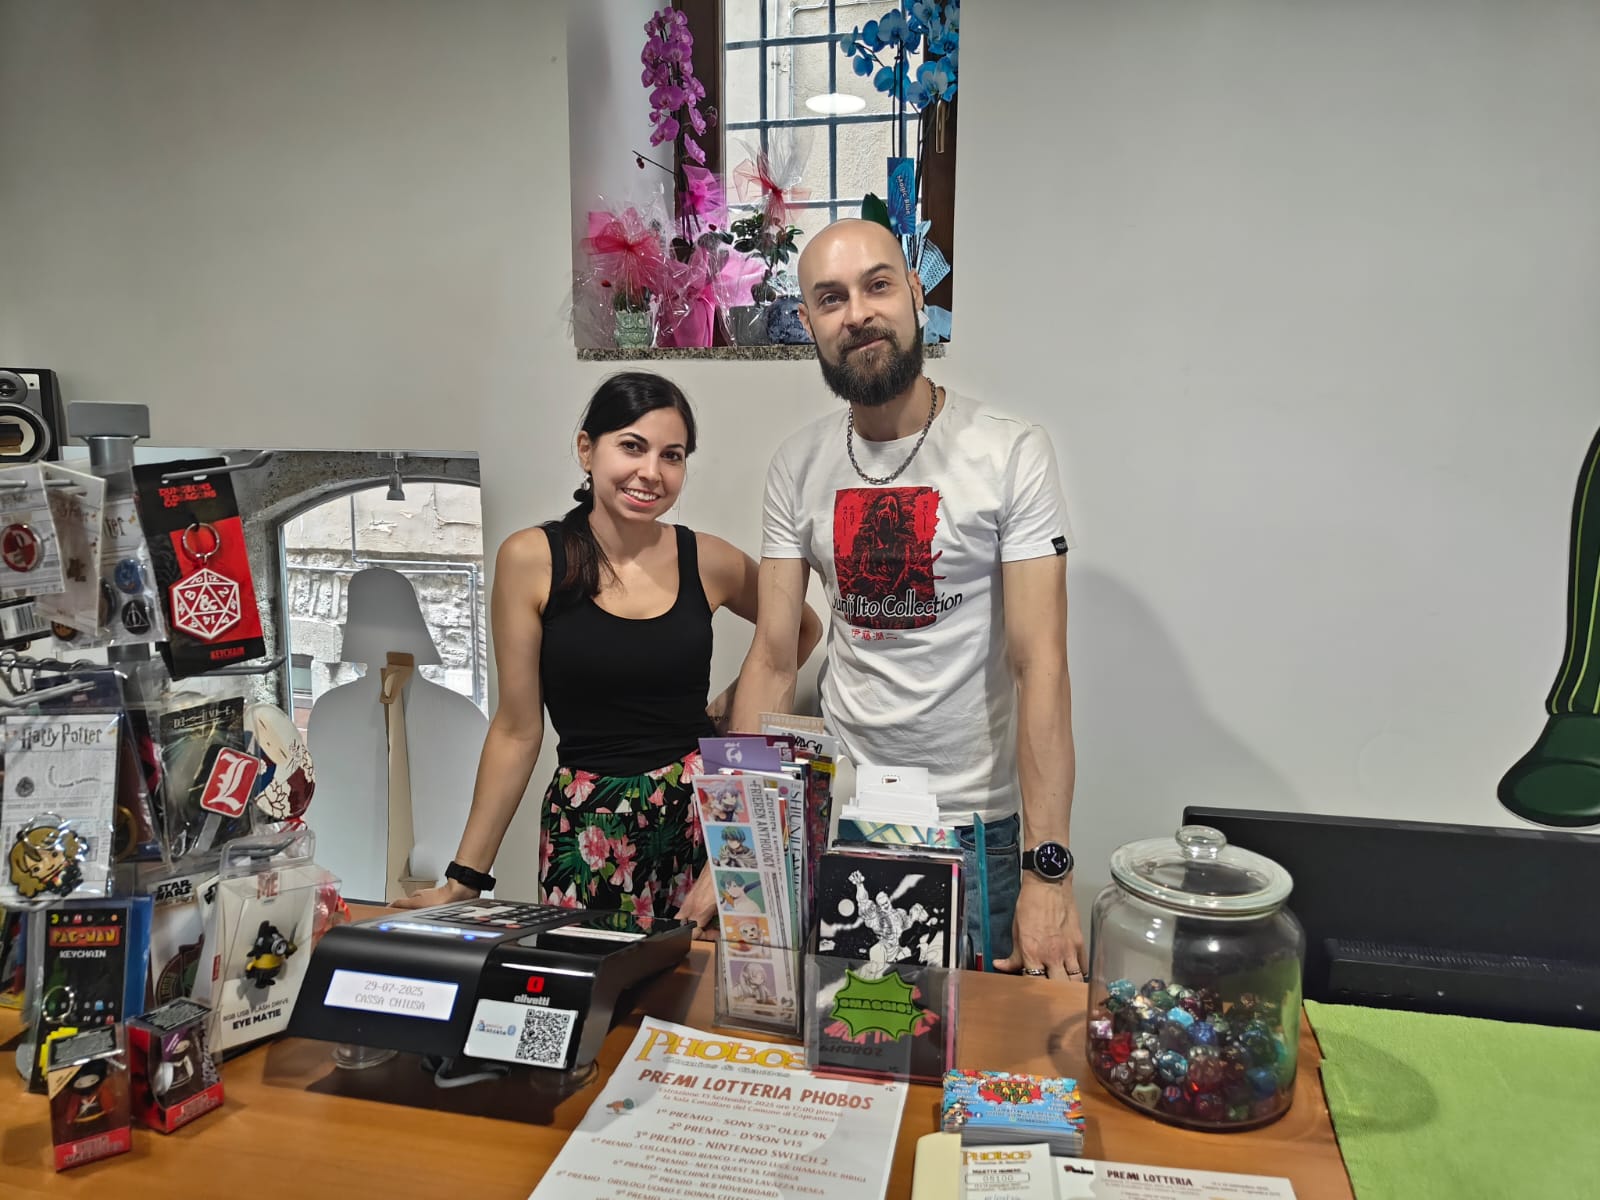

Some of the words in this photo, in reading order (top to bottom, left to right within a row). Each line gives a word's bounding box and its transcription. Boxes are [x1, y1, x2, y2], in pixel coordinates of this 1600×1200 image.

[882, 588, 963, 617] Collection
[19, 726, 60, 750] Harry
[61, 723, 103, 752] Potter
[756, 821, 776, 868] ANTHOLOGY
[155, 886, 193, 901] WARS
[157, 879, 193, 892] STAR
[53, 928, 116, 943] PAC-MAN
[59, 949, 107, 958] KEYCHAIN
[364, 980, 425, 997] 29-07-2025
[513, 994, 551, 1006] olivetti
[354, 993, 385, 1006] CASSA
[389, 997, 426, 1011] CHIUSA
[232, 1017, 251, 1030] EYE
[252, 1008, 282, 1024] MATIE
[634, 1026, 806, 1070] PHOBOS
[638, 1069, 698, 1088] PREMI
[702, 1077, 792, 1101] LOTTERIA
[800, 1089, 874, 1110] PHOBOS
[668, 1110, 714, 1122] PREMIO
[723, 1119, 757, 1128] SONY
[778, 1126, 809, 1137] OLED
[811, 1132, 827, 1140] 4K
[683, 1123, 729, 1137] PREMIO
[739, 1131, 779, 1144] DYSON
[783, 1139, 803, 1148] V15
[601, 1139, 633, 1149] PREMIO
[639, 1143, 677, 1155] COLLANA
[678, 1150, 697, 1159] ORO
[698, 1152, 730, 1162] BIANCO
[738, 1158, 767, 1167] PUNTO
[792, 1164, 838, 1178] DIAMANTE
[649, 1132, 695, 1147] PREMIO
[705, 1141, 768, 1157] NINTENDO
[771, 1150, 818, 1164] SWITCH
[820, 1157, 829, 1166] 2
[655, 1155, 688, 1166] PREMIO
[694, 1161, 719, 1170] META
[720, 1164, 748, 1173] QUEST
[567, 1171, 601, 1182] PREMIO
[607, 1177, 646, 1189] OROLOGI
[646, 1183, 675, 1193] UOMO
[683, 1189, 716, 1200] DONNA
[623, 1161, 657, 1171] PREMIO
[663, 1167, 709, 1179] MACCHINA
[711, 1172, 754, 1184] ESPRESSO
[755, 1178, 795, 1191] LAVAZZA
[658, 1176, 693, 1187] PREMIO
[718, 1183, 779, 1198] HOVERBOARD
[1106, 1169, 1140, 1181] PREMI
[1143, 1173, 1194, 1186] LOTTERIA
